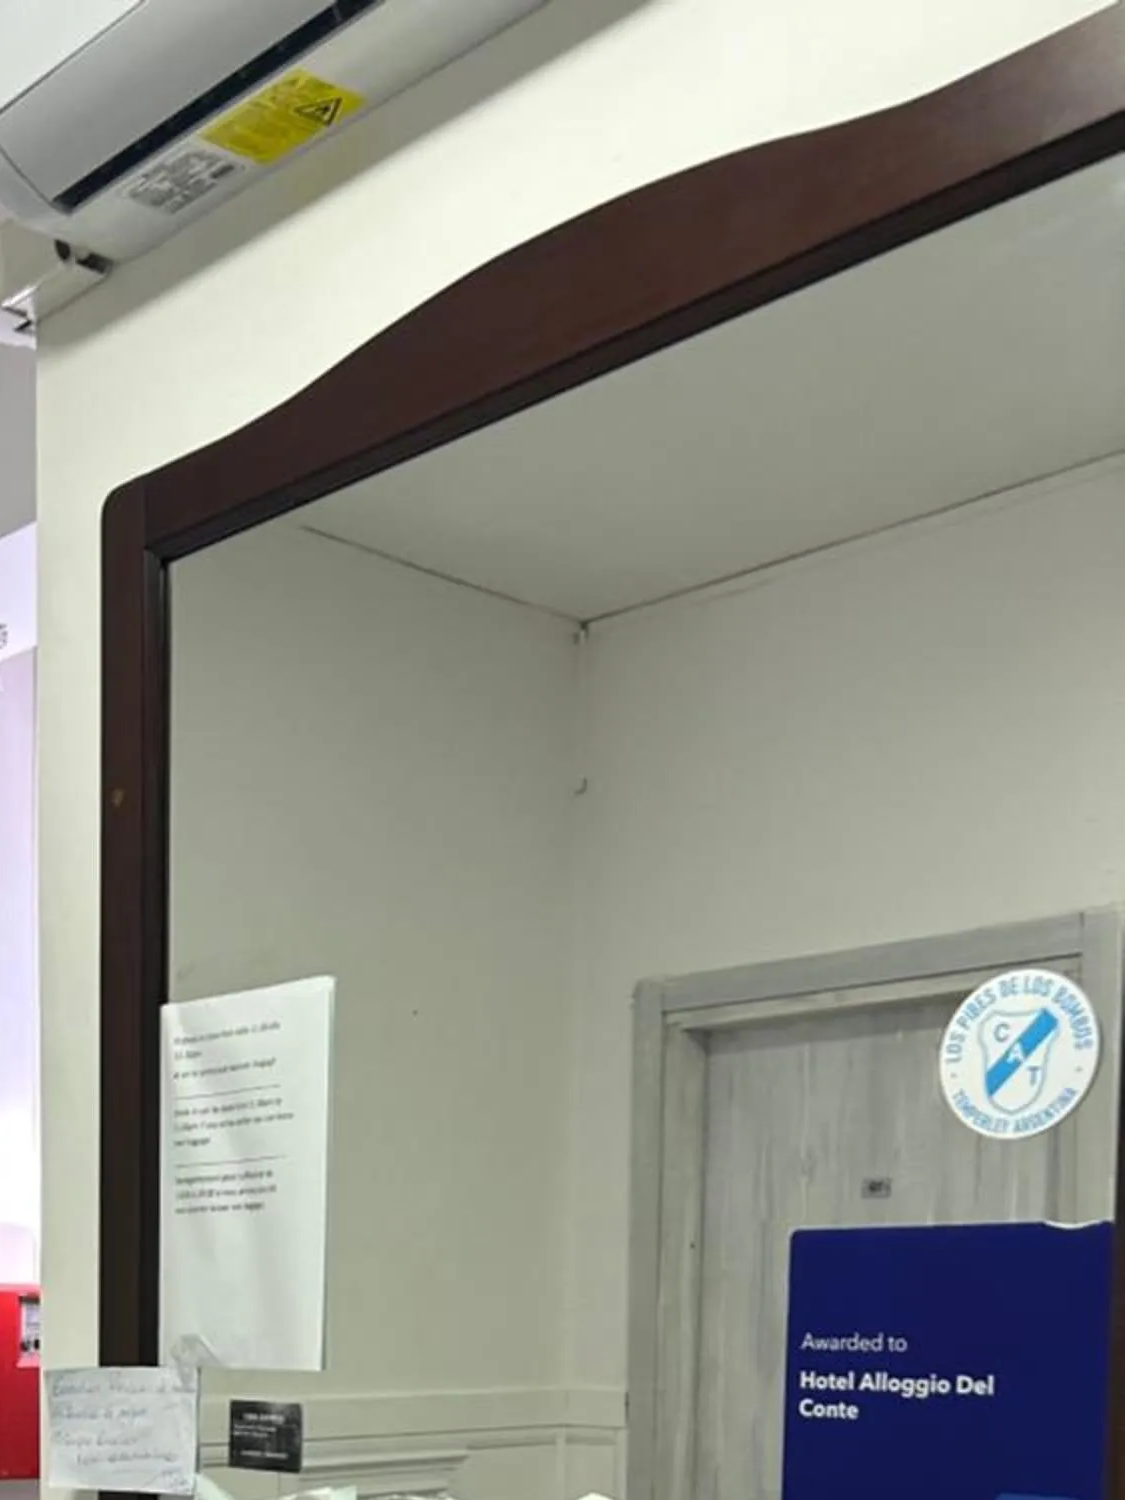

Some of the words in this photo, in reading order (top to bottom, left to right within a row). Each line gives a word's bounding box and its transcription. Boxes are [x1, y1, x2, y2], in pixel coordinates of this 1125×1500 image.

[998, 976, 1020, 998] DE
[993, 1023, 1011, 1042] C
[1027, 1065, 1042, 1087] T
[801, 1332, 884, 1352] Awarded
[888, 1336, 908, 1353] to
[800, 1370, 855, 1391] Hotel
[859, 1371, 952, 1399] Alloggio
[956, 1374, 995, 1396] Del
[798, 1398, 859, 1420] Conte
